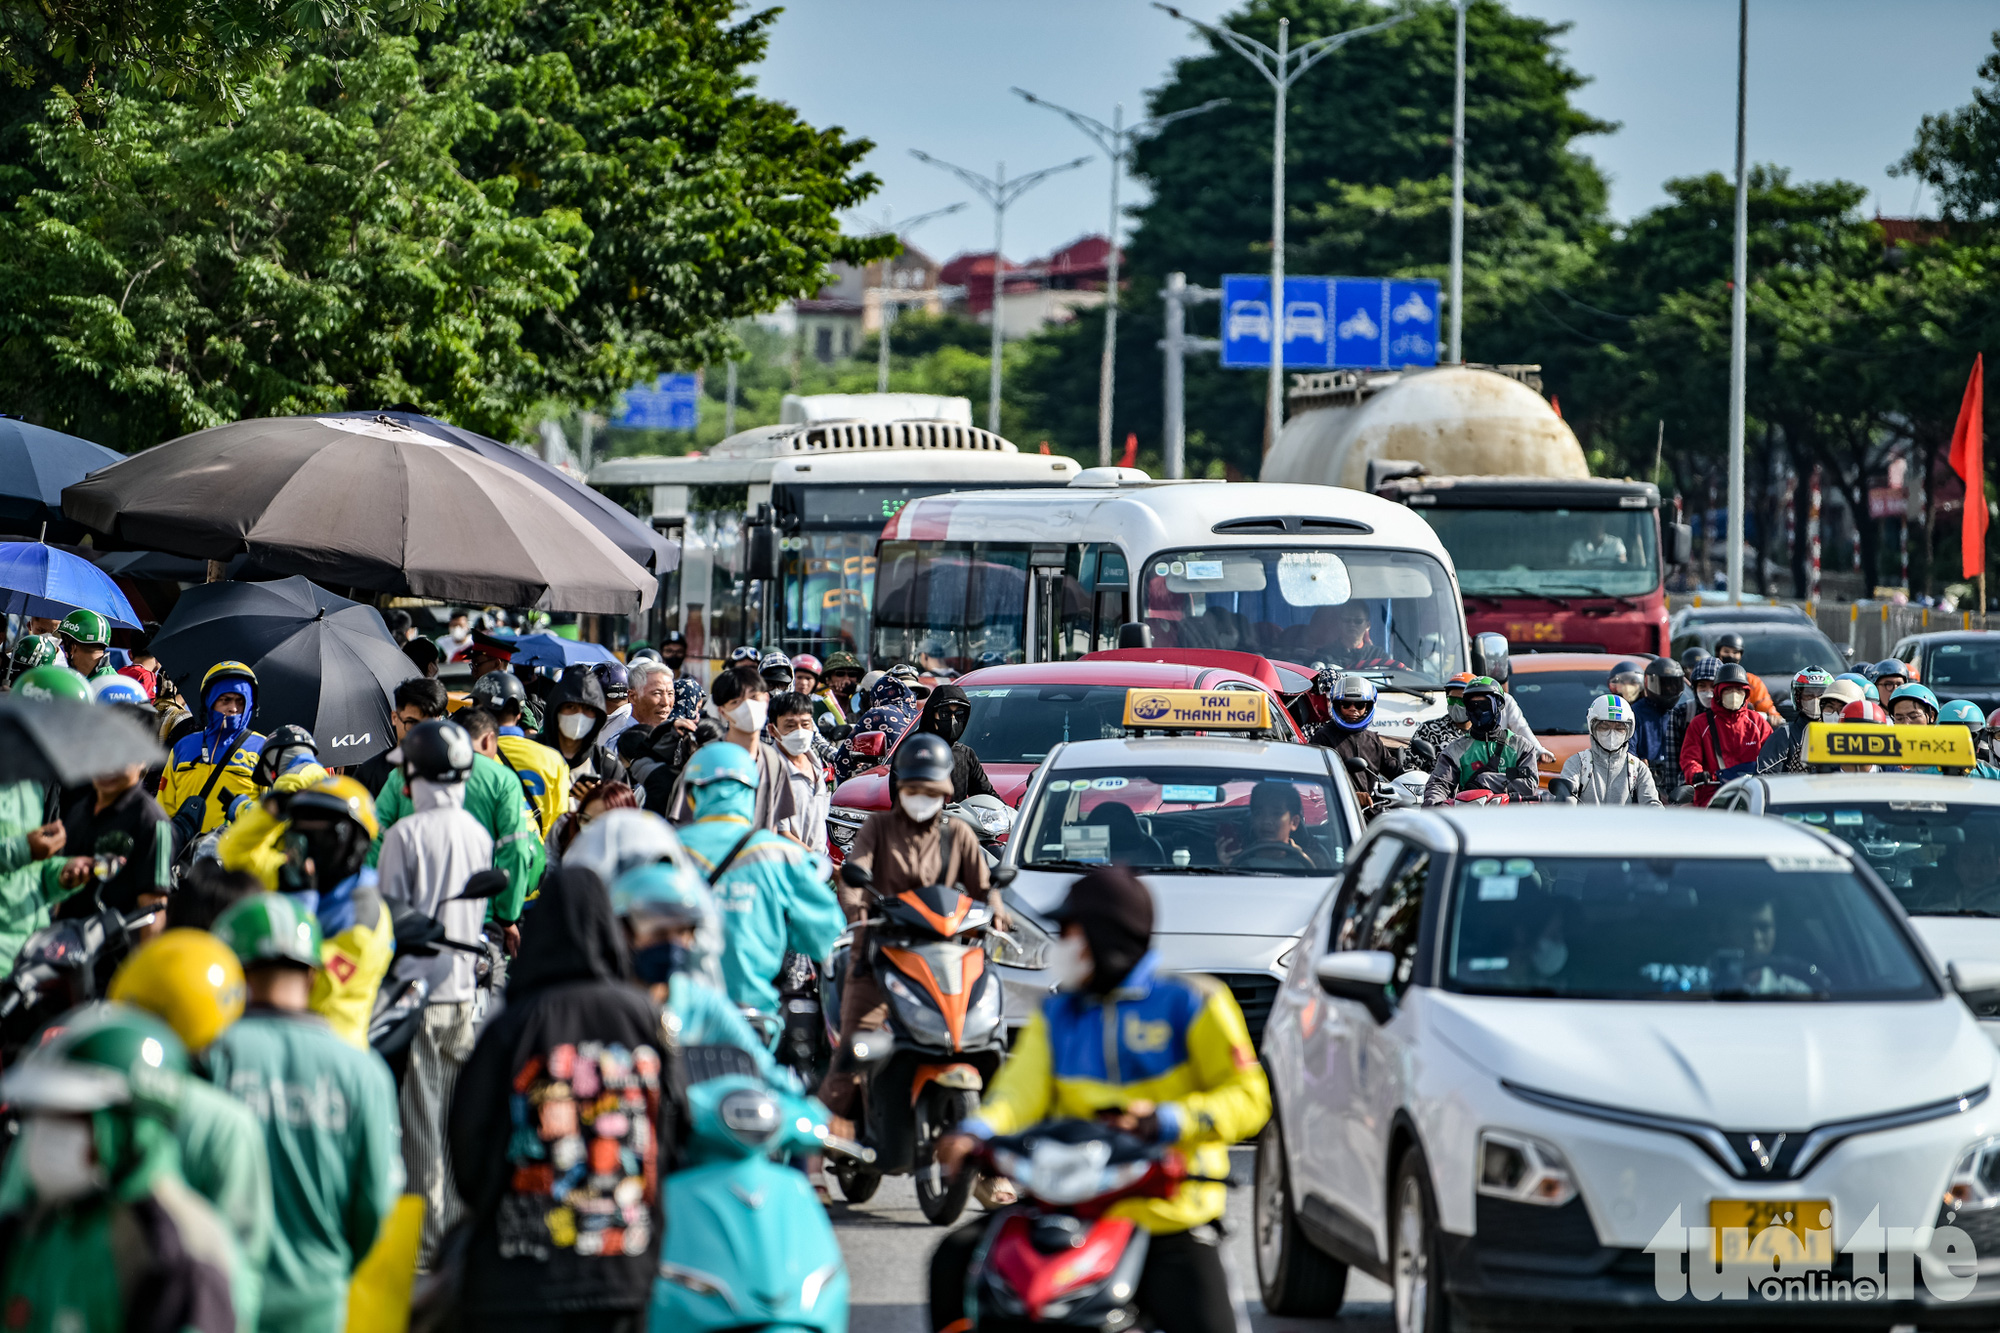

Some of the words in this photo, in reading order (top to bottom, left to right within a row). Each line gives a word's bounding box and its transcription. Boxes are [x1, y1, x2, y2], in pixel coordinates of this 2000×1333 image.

[63, 620, 80, 632] Grab
[109, 692, 132, 701] TANA
[1200, 696, 1230, 707] TAXI
[1173, 709, 1222, 721] THANH
[1227, 710, 1256, 722] NGA
[331, 732, 371, 748] KIA
[1833, 735, 1896, 754] EMDI
[1906, 739, 1956, 753] TAXI
[1649, 962, 1711, 985] TAXI
